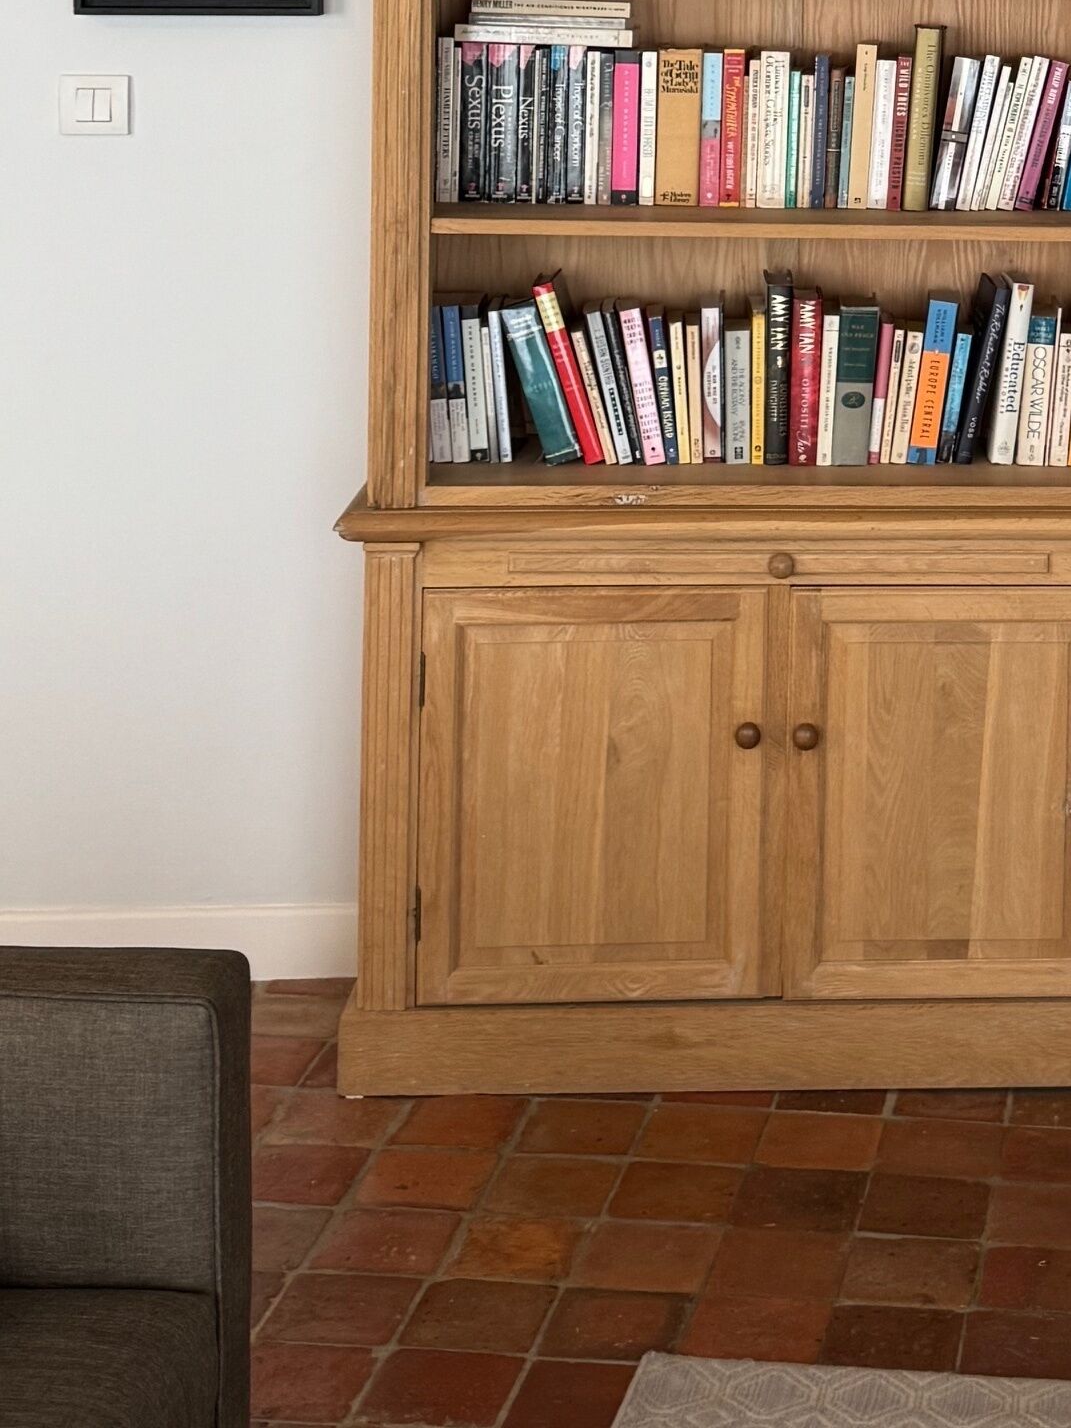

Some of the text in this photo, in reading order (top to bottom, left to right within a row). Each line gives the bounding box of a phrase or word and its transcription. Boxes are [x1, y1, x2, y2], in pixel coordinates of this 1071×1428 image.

[927, 44, 936, 62] The
[465, 76, 484, 128] Sexus
[492, 86, 513, 147] Plexus
[518, 97, 532, 139] Nexus
[553, 126, 564, 161] Cancer
[918, 122, 930, 166] Dilemma
[771, 295, 789, 350] AMY TAN
[799, 304, 815, 354] AMY TAN
[919, 360, 940, 438] EUROPE CENTRAL
[1006, 342, 1025, 413] Educated
[1027, 347, 1047, 439] OSCAR WILDE
[968, 417, 977, 438] VOSS
